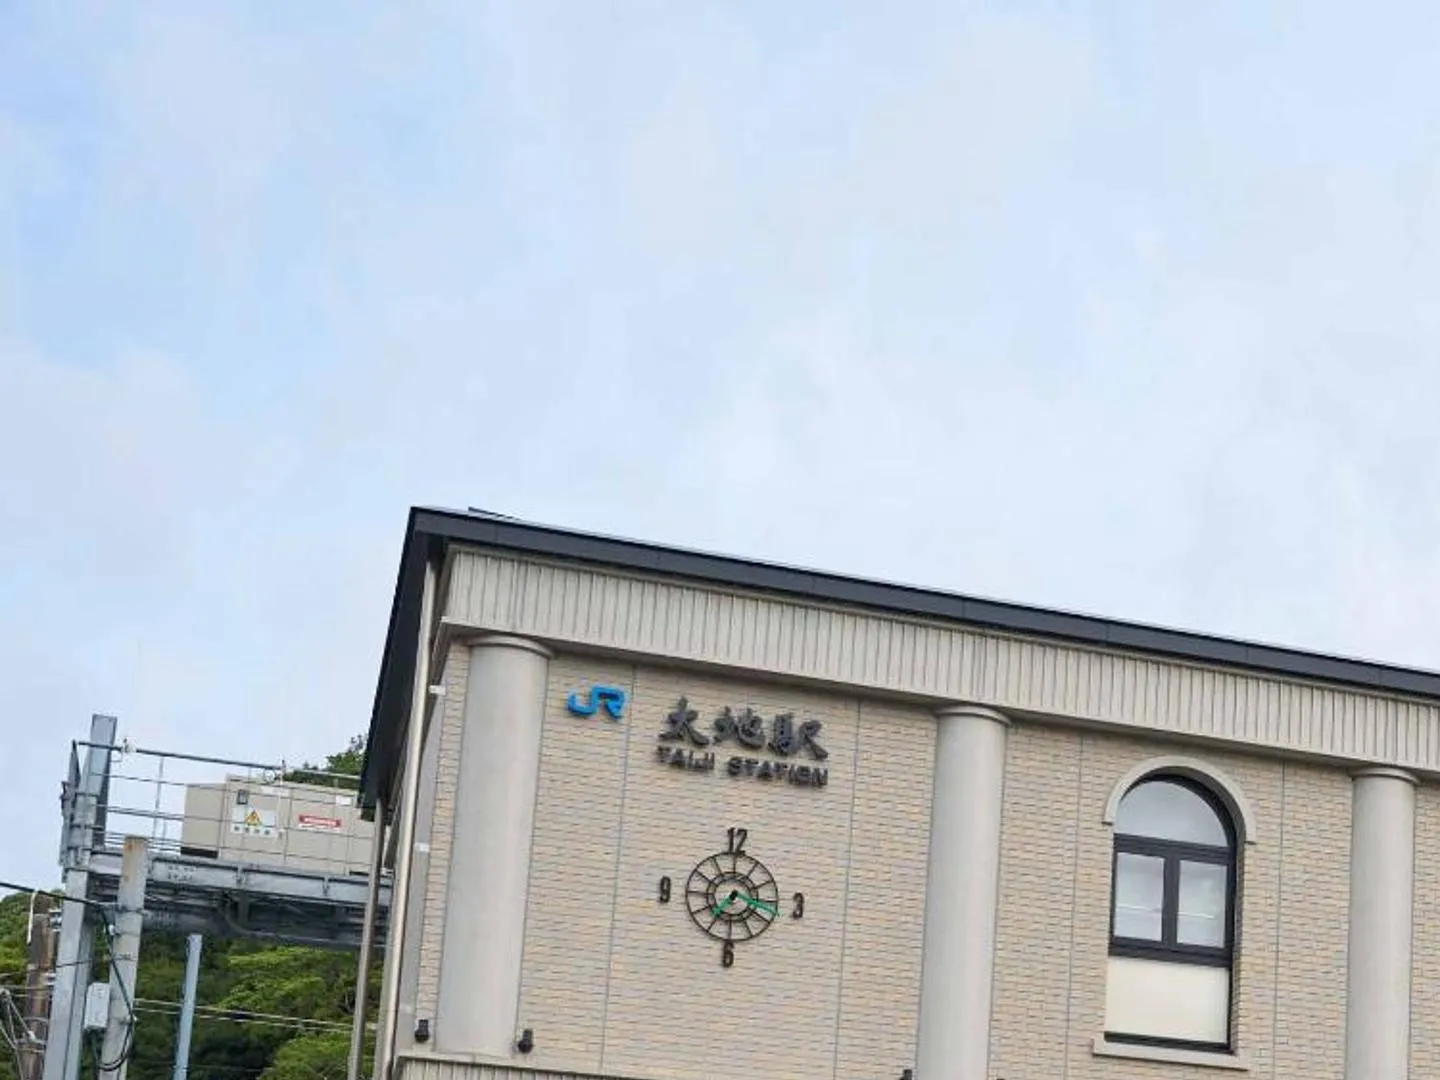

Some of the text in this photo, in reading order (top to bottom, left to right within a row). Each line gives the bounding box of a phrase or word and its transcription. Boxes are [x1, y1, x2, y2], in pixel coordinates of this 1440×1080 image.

[566, 684, 625, 720] JR
[727, 827, 748, 855] 12
[659, 876, 671, 904] 9
[792, 893, 804, 918] 3
[721, 941, 735, 968] 6
